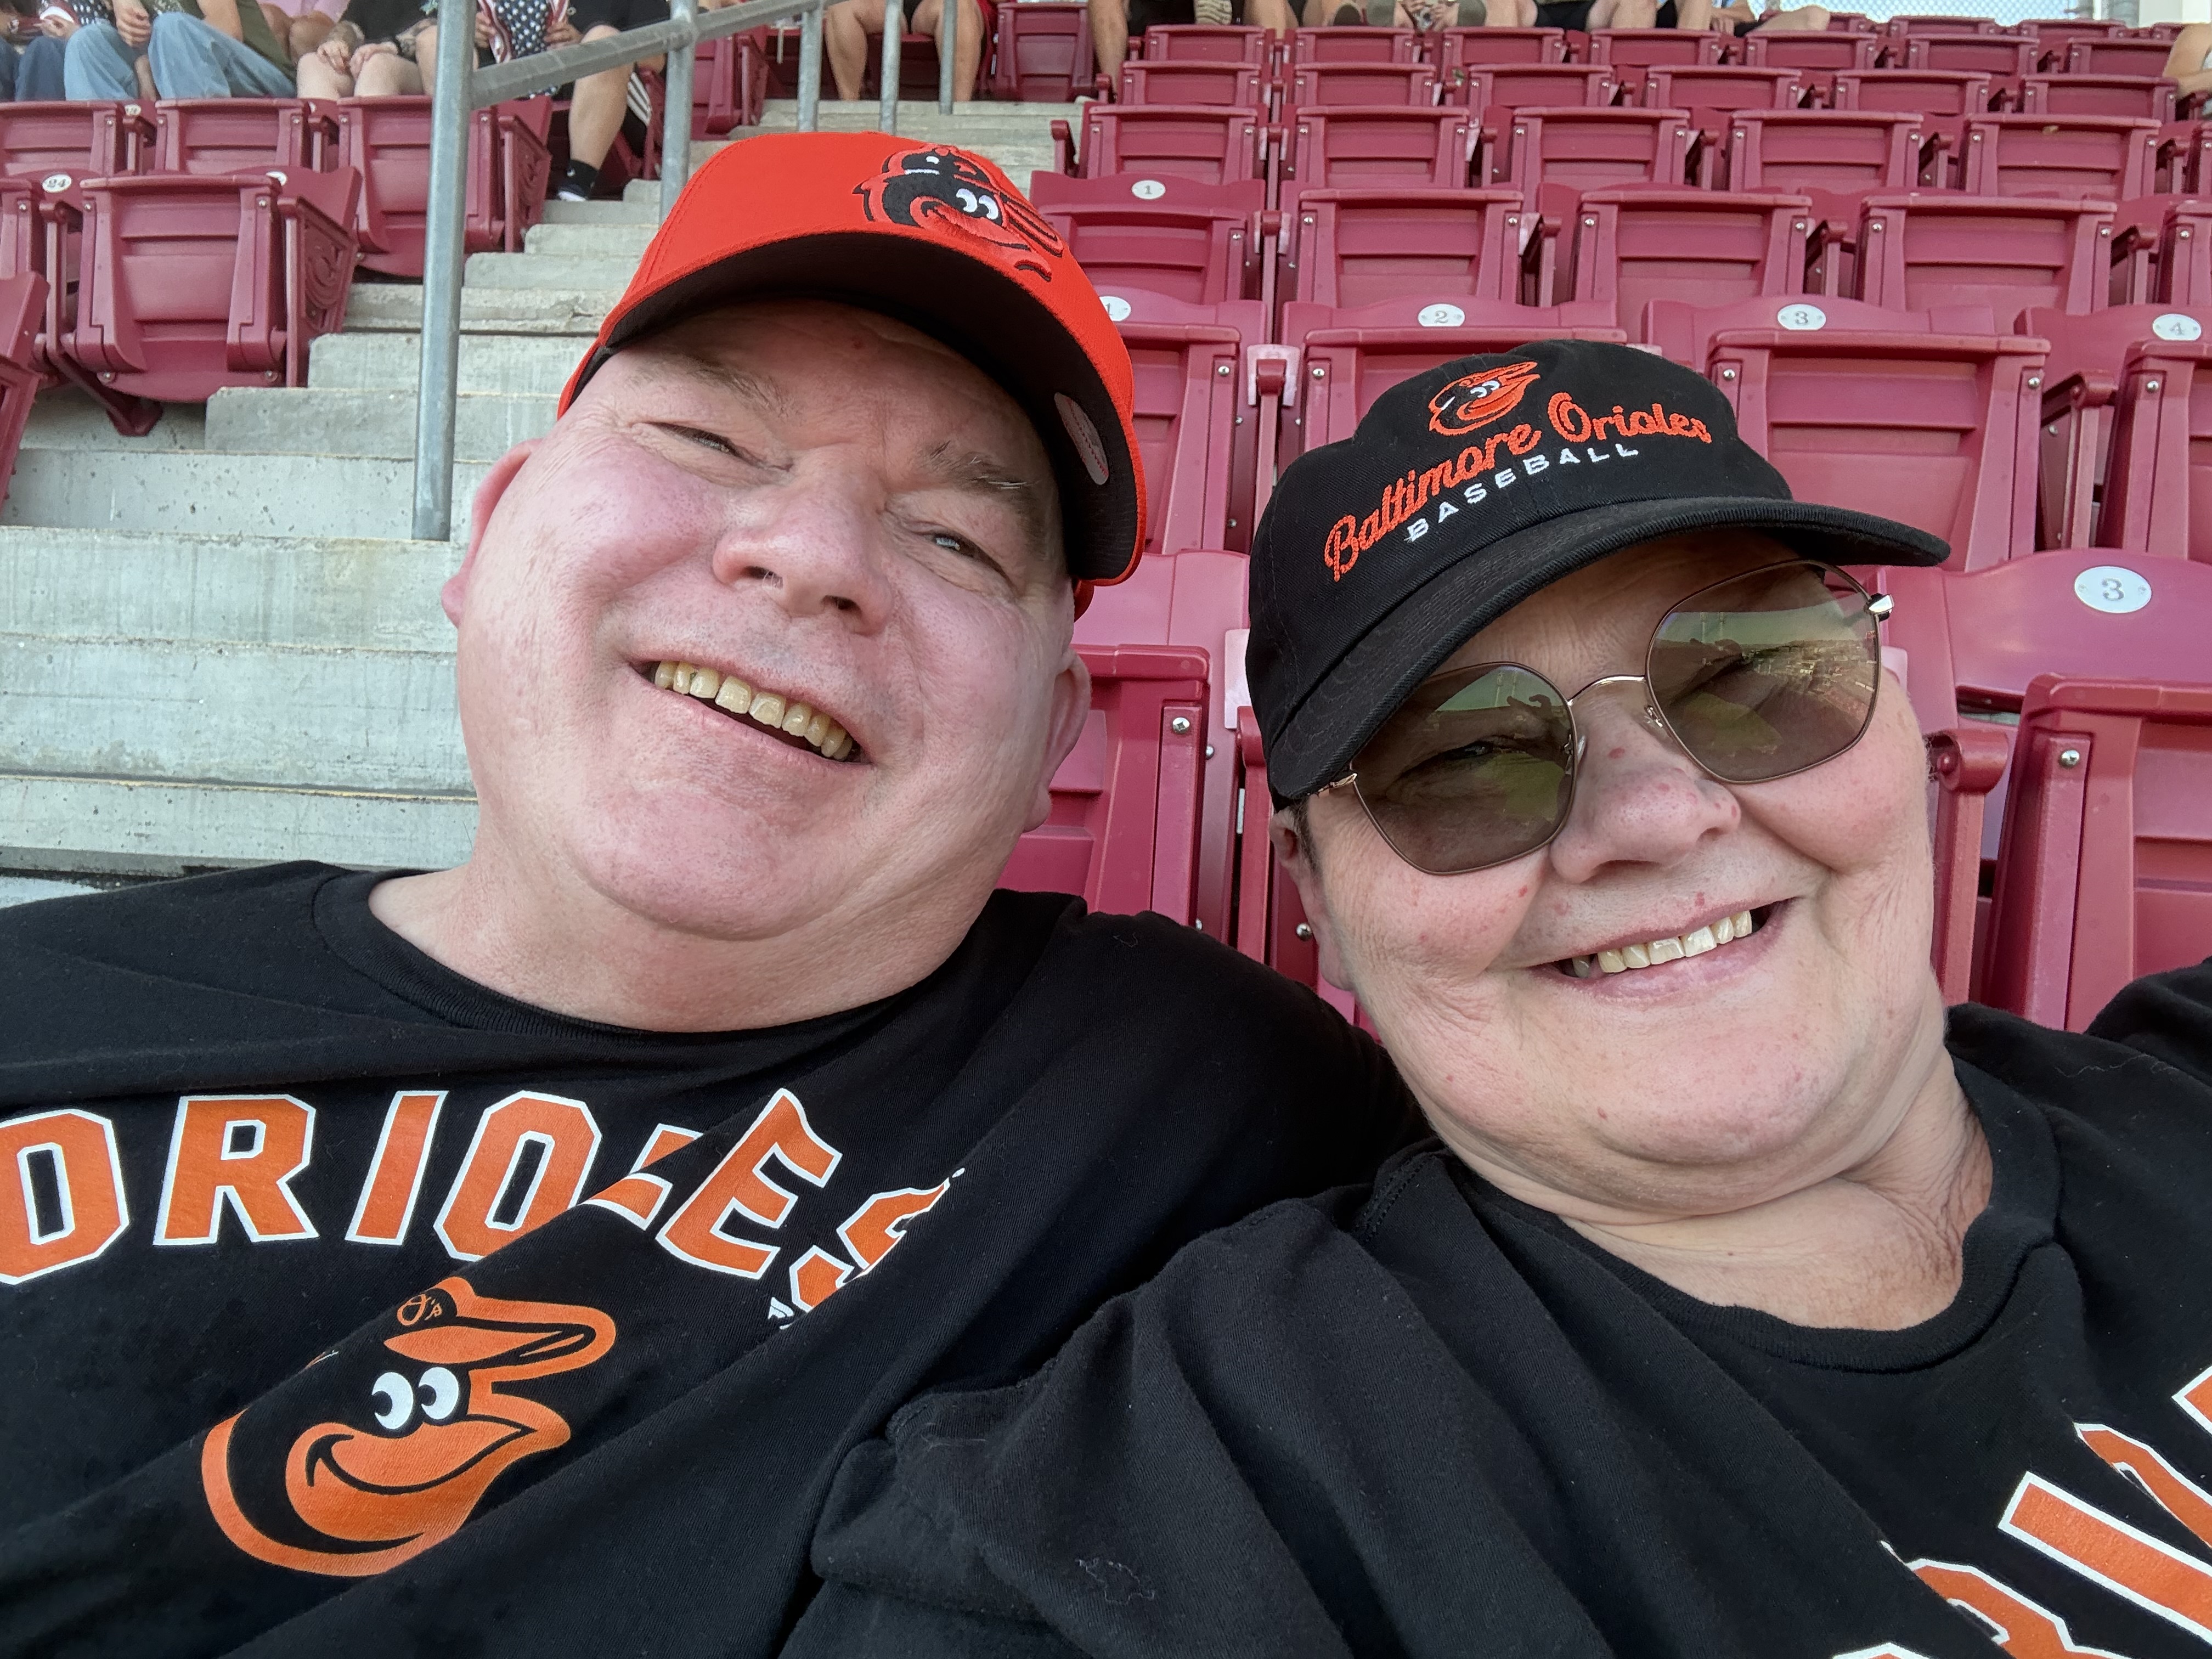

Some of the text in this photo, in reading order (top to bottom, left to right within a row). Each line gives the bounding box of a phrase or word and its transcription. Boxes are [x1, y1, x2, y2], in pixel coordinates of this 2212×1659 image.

[1144, 185, 1153, 194] 1
[1434, 310, 1448, 324] 2
[1794, 311, 1809, 325] 3
[2169, 321, 2185, 335] 4
[1324, 392, 1712, 582] Baltimore Orioles
[1404, 443, 1639, 543] BASEBALL
[2101, 577, 2124, 601] 3
